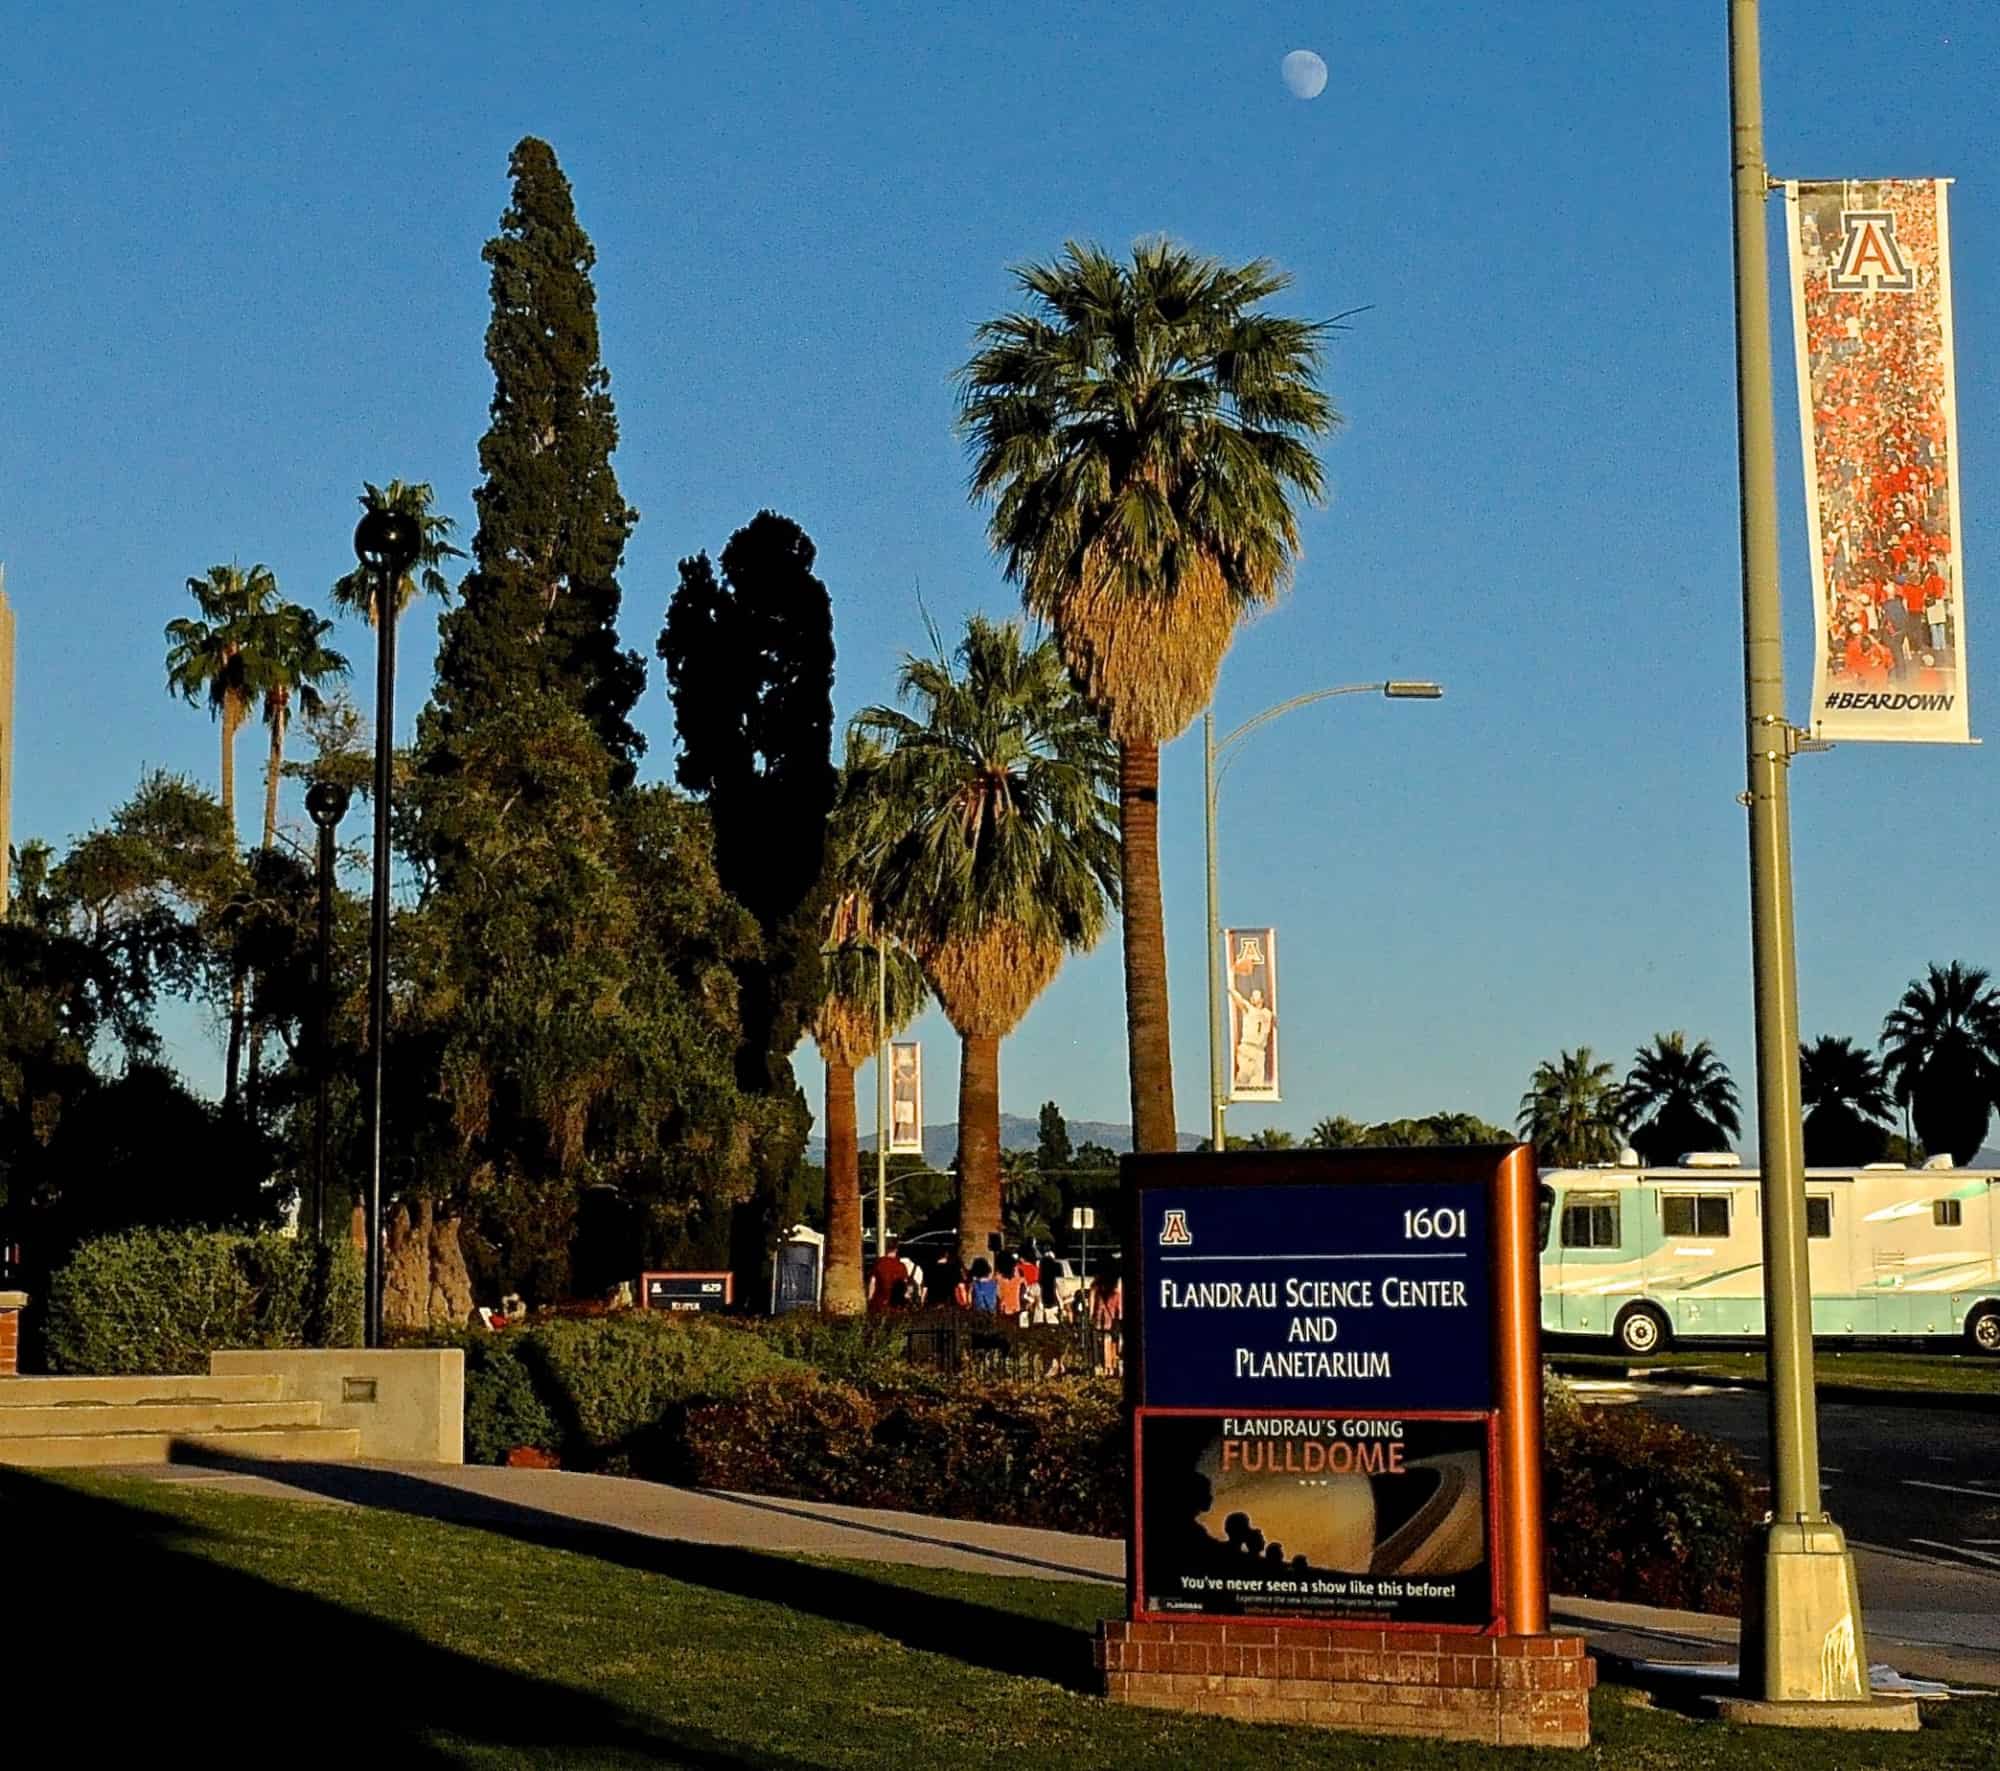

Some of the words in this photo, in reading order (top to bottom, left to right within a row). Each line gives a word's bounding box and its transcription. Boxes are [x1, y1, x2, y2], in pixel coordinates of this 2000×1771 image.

[1827, 210, 1916, 292] A
[1825, 692, 1954, 711] #BEARDOWN
[1160, 1210, 1192, 1245] A
[1404, 1208, 1466, 1239] 1601
[1160, 1279, 1277, 1308] FLANDRAU
[1286, 1278, 1373, 1308] SCIENCE
[1382, 1277, 1468, 1307] CENTER
[1288, 1317, 1338, 1343] AND
[1235, 1349, 1391, 1378] PLANETARIUM
[1223, 1418, 1337, 1437] FLANDRAU'S
[1342, 1419, 1404, 1438] GOING
[1222, 1440, 1406, 1473] FULLDOME
[1180, 1576, 1223, 1589] You've
[1226, 1579, 1263, 1591] never
[1266, 1581, 1297, 1592] seen
[1300, 1582, 1309, 1593] a
[1311, 1579, 1346, 1593] show
[1349, 1580, 1374, 1594] like
[1378, 1581, 1403, 1596] this
[1406, 1582, 1456, 1597] before!
